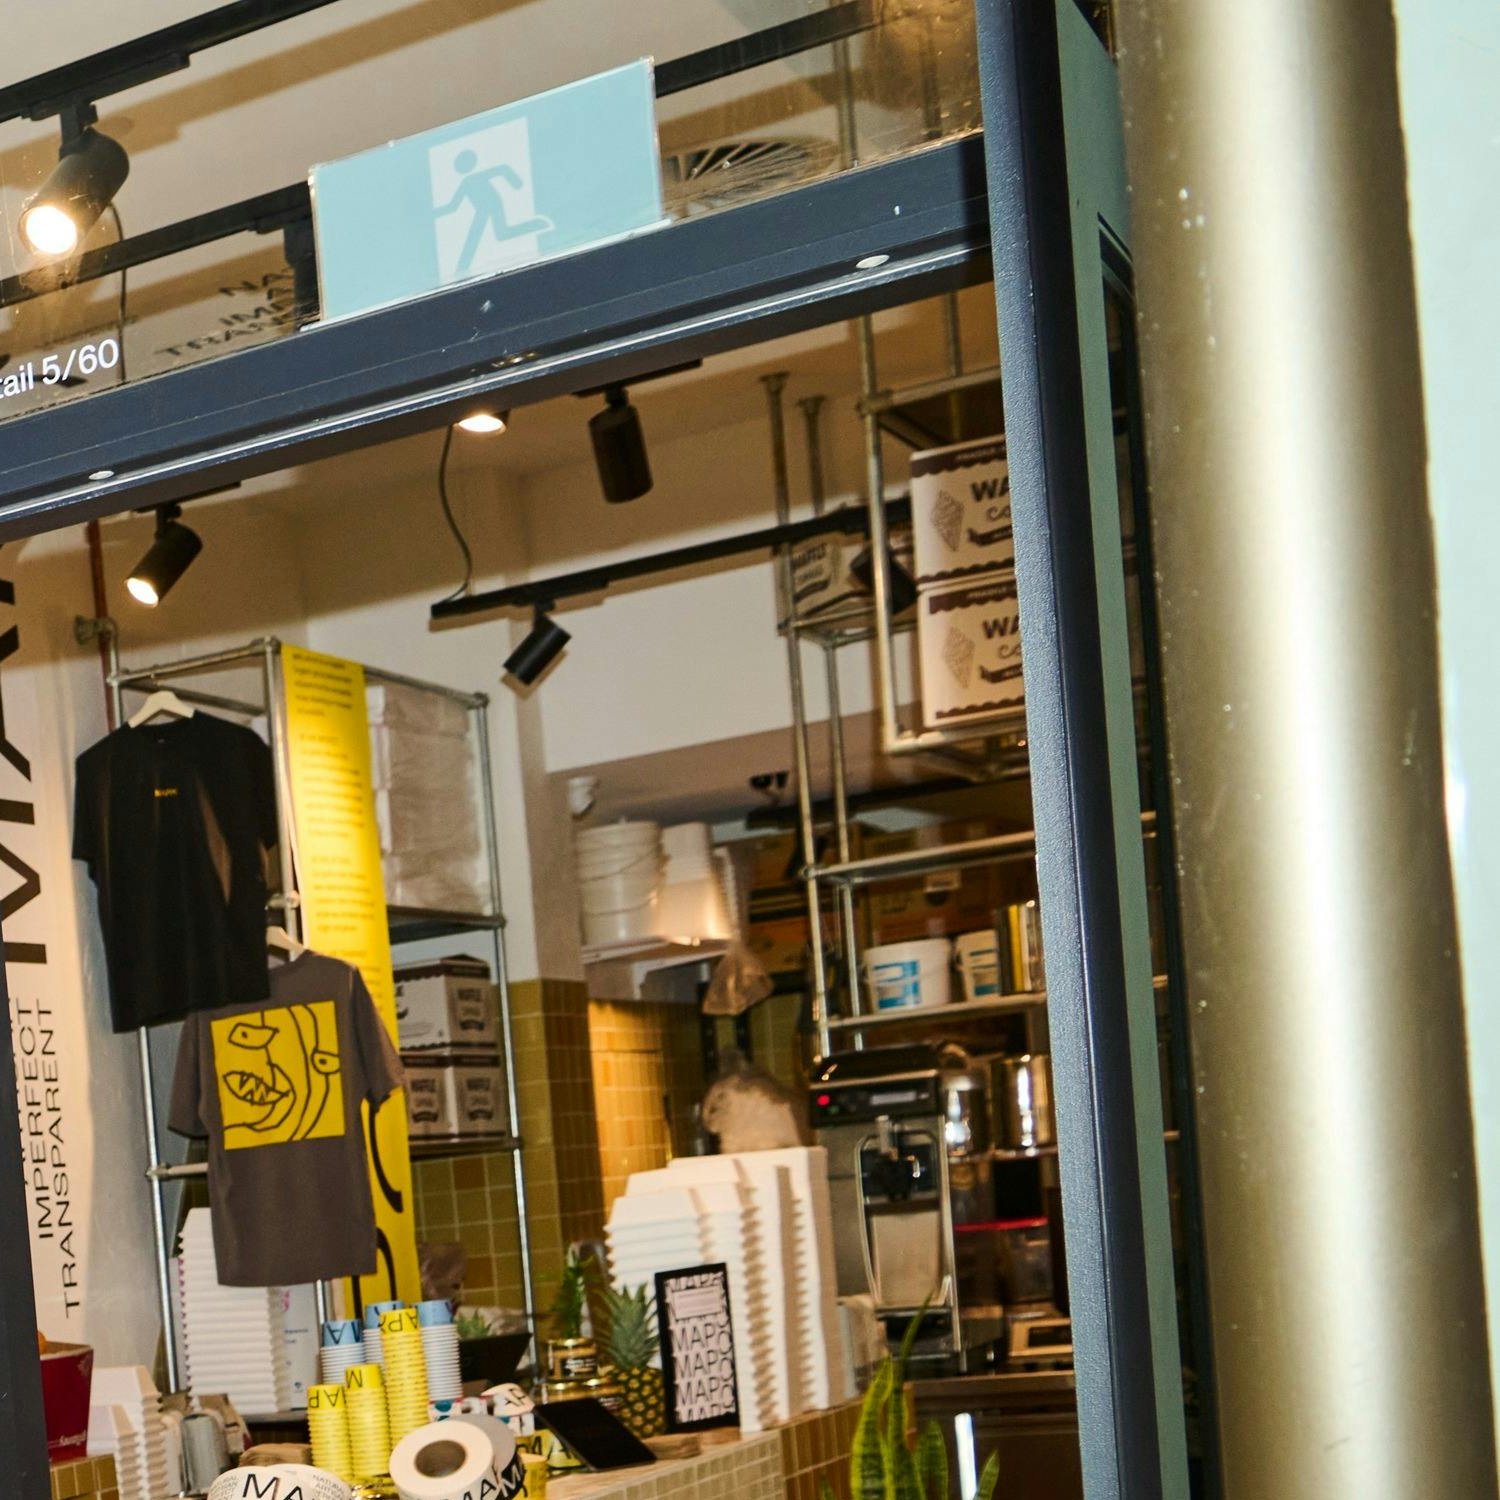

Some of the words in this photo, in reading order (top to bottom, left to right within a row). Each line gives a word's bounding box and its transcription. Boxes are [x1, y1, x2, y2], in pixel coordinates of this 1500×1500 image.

[42, 338, 119, 386] 5/60
[16, 998, 54, 1239] IMPERFECT
[36, 998, 80, 1319] TRANSPARENT
[671, 1322, 733, 1355] MAPO
[674, 1349, 735, 1382] MAPO
[676, 1376, 737, 1409] MAPO
